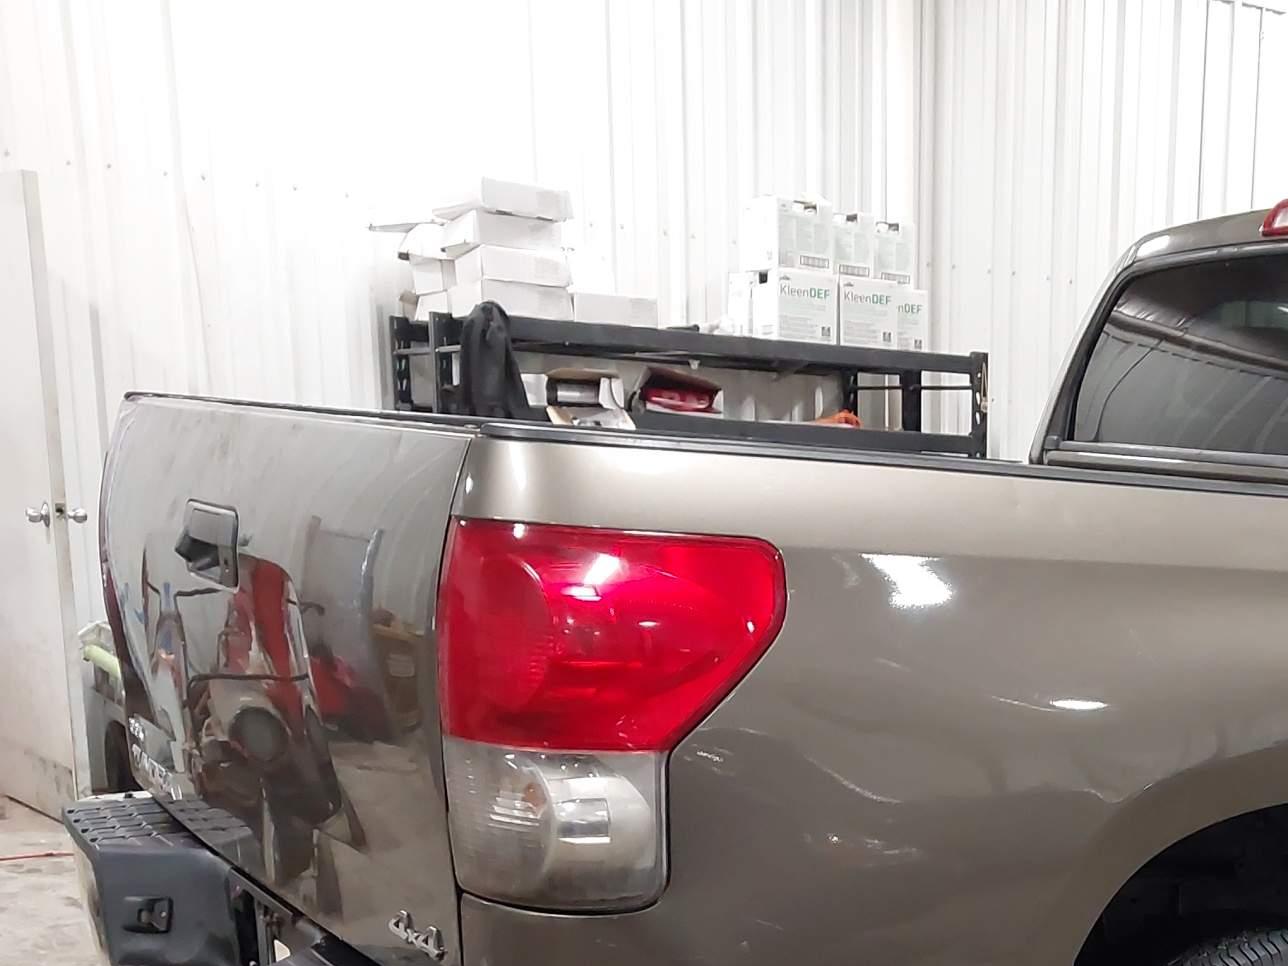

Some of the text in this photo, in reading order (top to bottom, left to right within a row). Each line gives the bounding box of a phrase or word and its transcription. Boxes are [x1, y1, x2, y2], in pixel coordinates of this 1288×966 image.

[780, 283, 831, 299] KleenDEF
[843, 290, 893, 305] KleenDEF
[897, 303, 923, 314] nDEF
